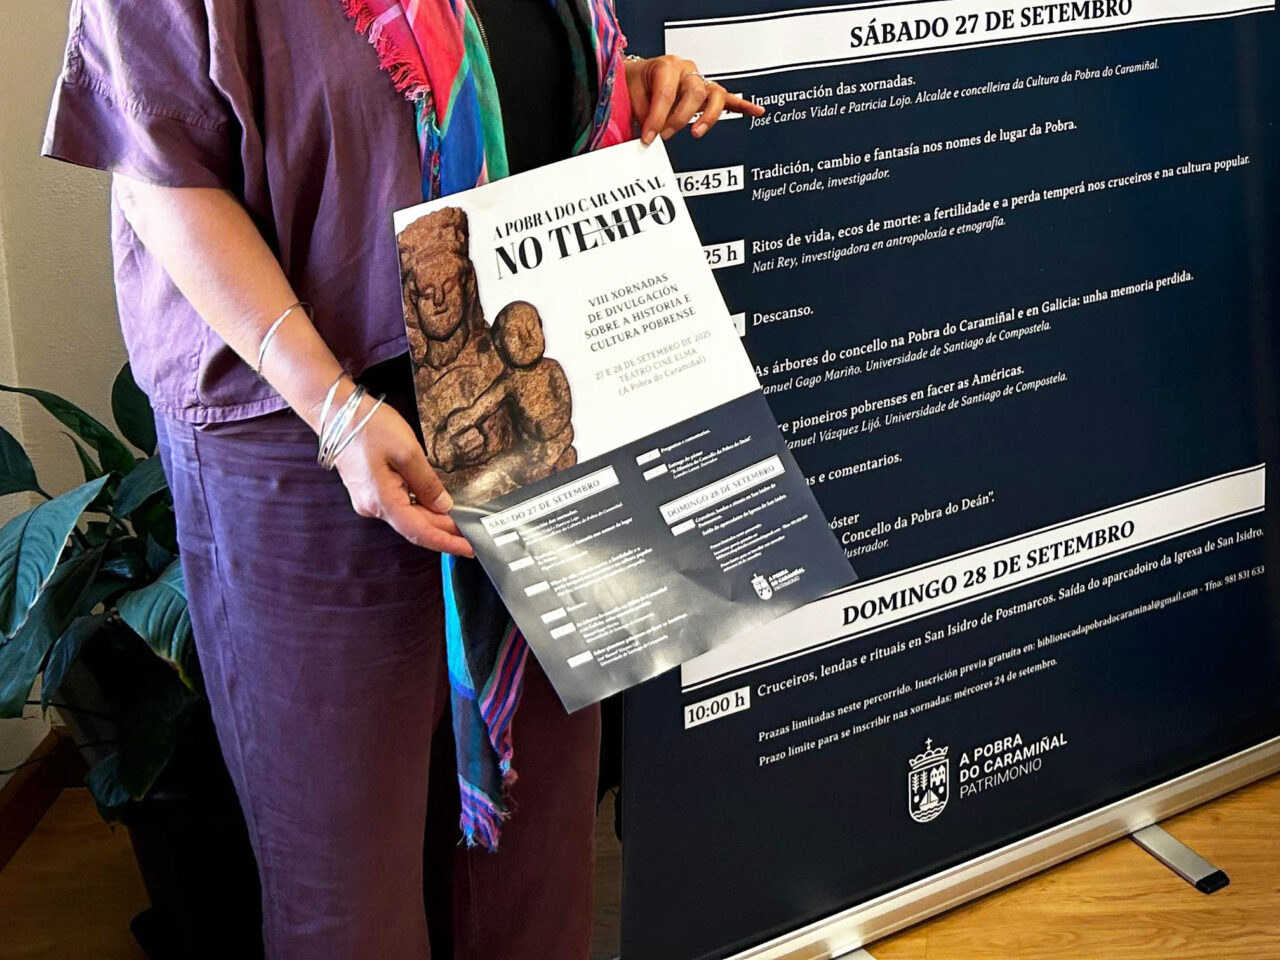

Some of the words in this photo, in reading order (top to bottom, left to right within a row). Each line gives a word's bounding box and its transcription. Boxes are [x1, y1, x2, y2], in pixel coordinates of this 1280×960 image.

[851, 17, 948, 48] SÁBADO
[956, 14, 978, 35] 27
[986, 9, 1014, 31] DE
[750, 84, 833, 106] Inauguración
[837, 82, 856, 95] das
[860, 74, 915, 92] xornadas.
[750, 110, 771, 129] José
[774, 109, 806, 123] Carlos
[810, 104, 838, 117] Vidal
[840, 106, 846, 114] e
[848, 98, 886, 113] Patricia
[890, 95, 912, 108] Lojo.
[915, 88, 951, 103] Alcalde
[954, 90, 959, 98] e
[961, 82, 1010, 96] concelleira
[1012, 78, 1024, 89] da
[1026, 75, 1059, 87] Cultura
[1061, 72, 1072, 82] da
[1074, 68, 1100, 80] Pobra
[1102, 66, 1113, 76] do
[1115, 59, 1158, 75] Caramiñal.
[751, 160, 813, 180] Tradición,
[818, 154, 861, 169] cambio
[864, 154, 870, 162] e
[874, 143, 919, 160] fantasía
[923, 142, 942, 153] nos
[946, 136, 981, 149] nomes
[984, 131, 996, 143] de
[1000, 129, 1027, 142] lugar
[1030, 124, 1042, 135] da
[1045, 120, 1076, 133] Pobra.
[677, 173, 721, 192] 16:45
[727, 170, 738, 186] h
[494, 226, 502, 240] A
[505, 210, 553, 238] POBRA
[555, 202, 576, 220] DO
[578, 177, 665, 211] CARAMIÑAL
[495, 236, 543, 280] NO
[548, 196, 676, 260] TEMPO
[588, 294, 608, 306] VIII
[611, 274, 668, 299] XORNADAS
[588, 312, 602, 323] DE
[605, 286, 678, 316] DIVULGACIÓN
[585, 320, 620, 339] SOBRE
[624, 317, 630, 325] A
[632, 298, 682, 322] HISTORIA
[684, 294, 691, 303] E
[591, 328, 640, 352] CULTURA
[642, 309, 695, 332] POBRENSE
[754, 307, 813, 325] Descanso.
[842, 522, 891, 544] Concello
[894, 517, 907, 529] da
[912, 509, 942, 525] Pobra
[946, 502, 958, 514] do
[843, 576, 956, 626] DOMINGO
[964, 566, 986, 588] 28
[994, 555, 1020, 579] DE
[1027, 521, 1134, 568] SETEMBRO
[758, 672, 817, 696] Cruceiros,
[821, 658, 857, 676] lendas
[861, 655, 866, 663] e
[870, 642, 905, 661] rituais
[909, 638, 921, 648] en
[925, 630, 944, 643] San
[948, 619, 978, 636] Isidro
[981, 612, 993, 624] de
[996, 595, 1056, 620] Postmarcos.
[1059, 583, 1085, 600] Saída
[1088, 578, 1100, 590] do
[1102, 561, 1158, 587] aparcadoiro
[1161, 556, 1171, 566] da
[1174, 547, 1202, 564] Igrexa
[1205, 542, 1215, 552] de
[1218, 537, 1233, 548] San
[1236, 529, 1263, 542] Isidro.
[688, 698, 730, 724] 10:00
[735, 693, 745, 708] h
[960, 753, 969, 766] A
[974, 734, 1022, 761] POBRA
[960, 765, 979, 782] DO
[984, 735, 1067, 772] CARAMIÑAL
[960, 758, 1041, 798] PATRIMONIO
